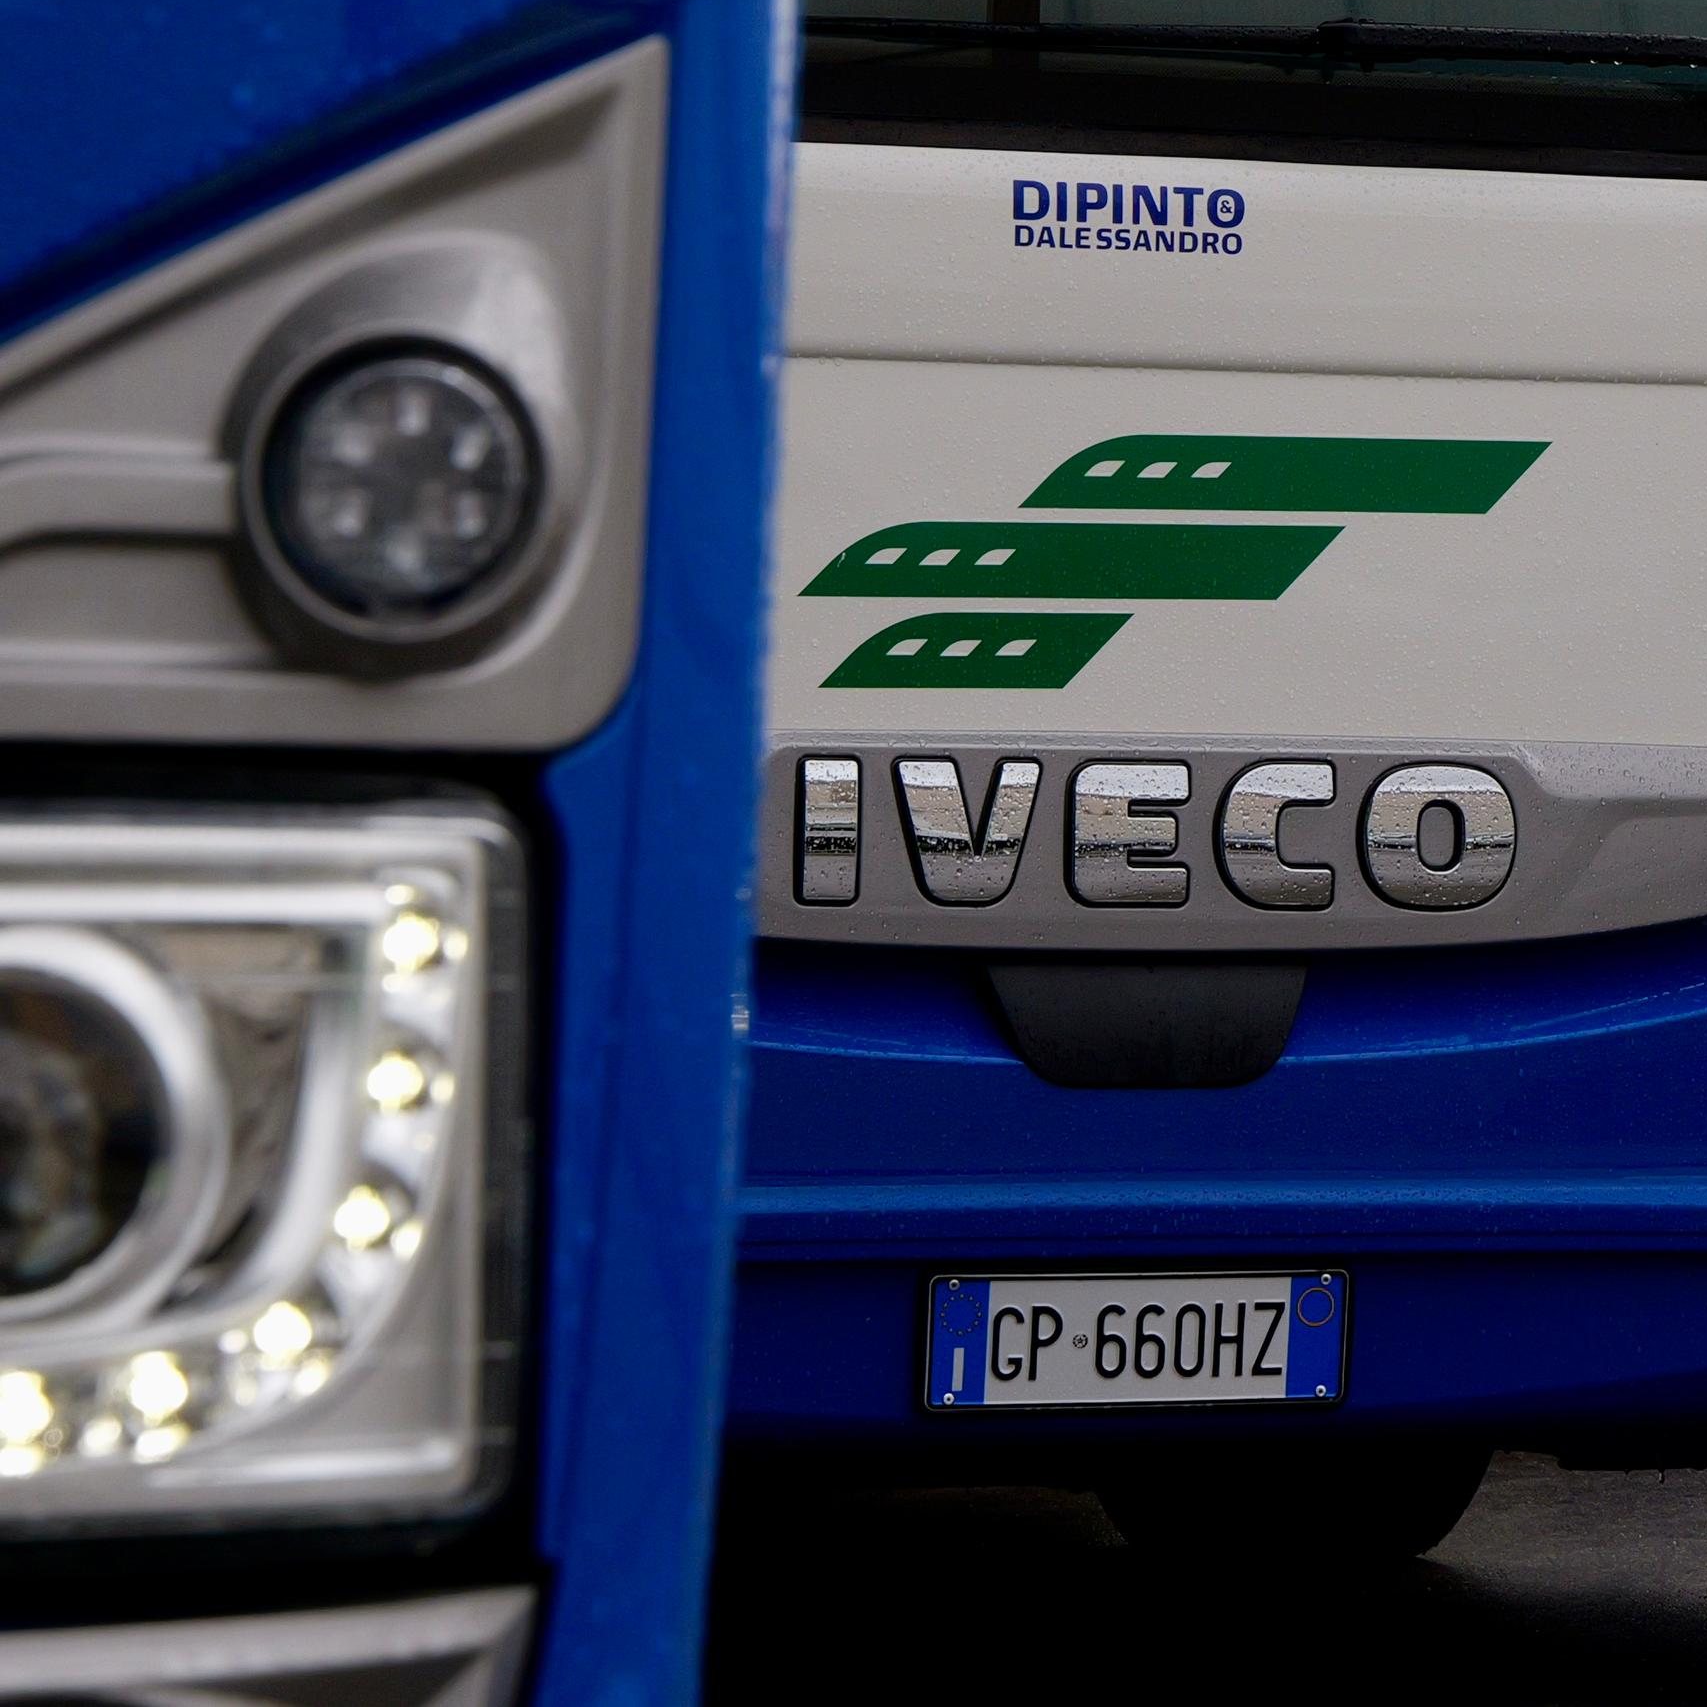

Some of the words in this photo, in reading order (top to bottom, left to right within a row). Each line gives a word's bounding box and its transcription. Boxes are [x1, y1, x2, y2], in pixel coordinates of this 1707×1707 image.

[1012, 179, 1246, 228] DIPINTO
[1013, 224, 1244, 255] DALESSANDRO
[792, 754, 1521, 912] IVECO
[990, 1305, 1064, 1382] GP
[1094, 1301, 1287, 1379] 660HZ
